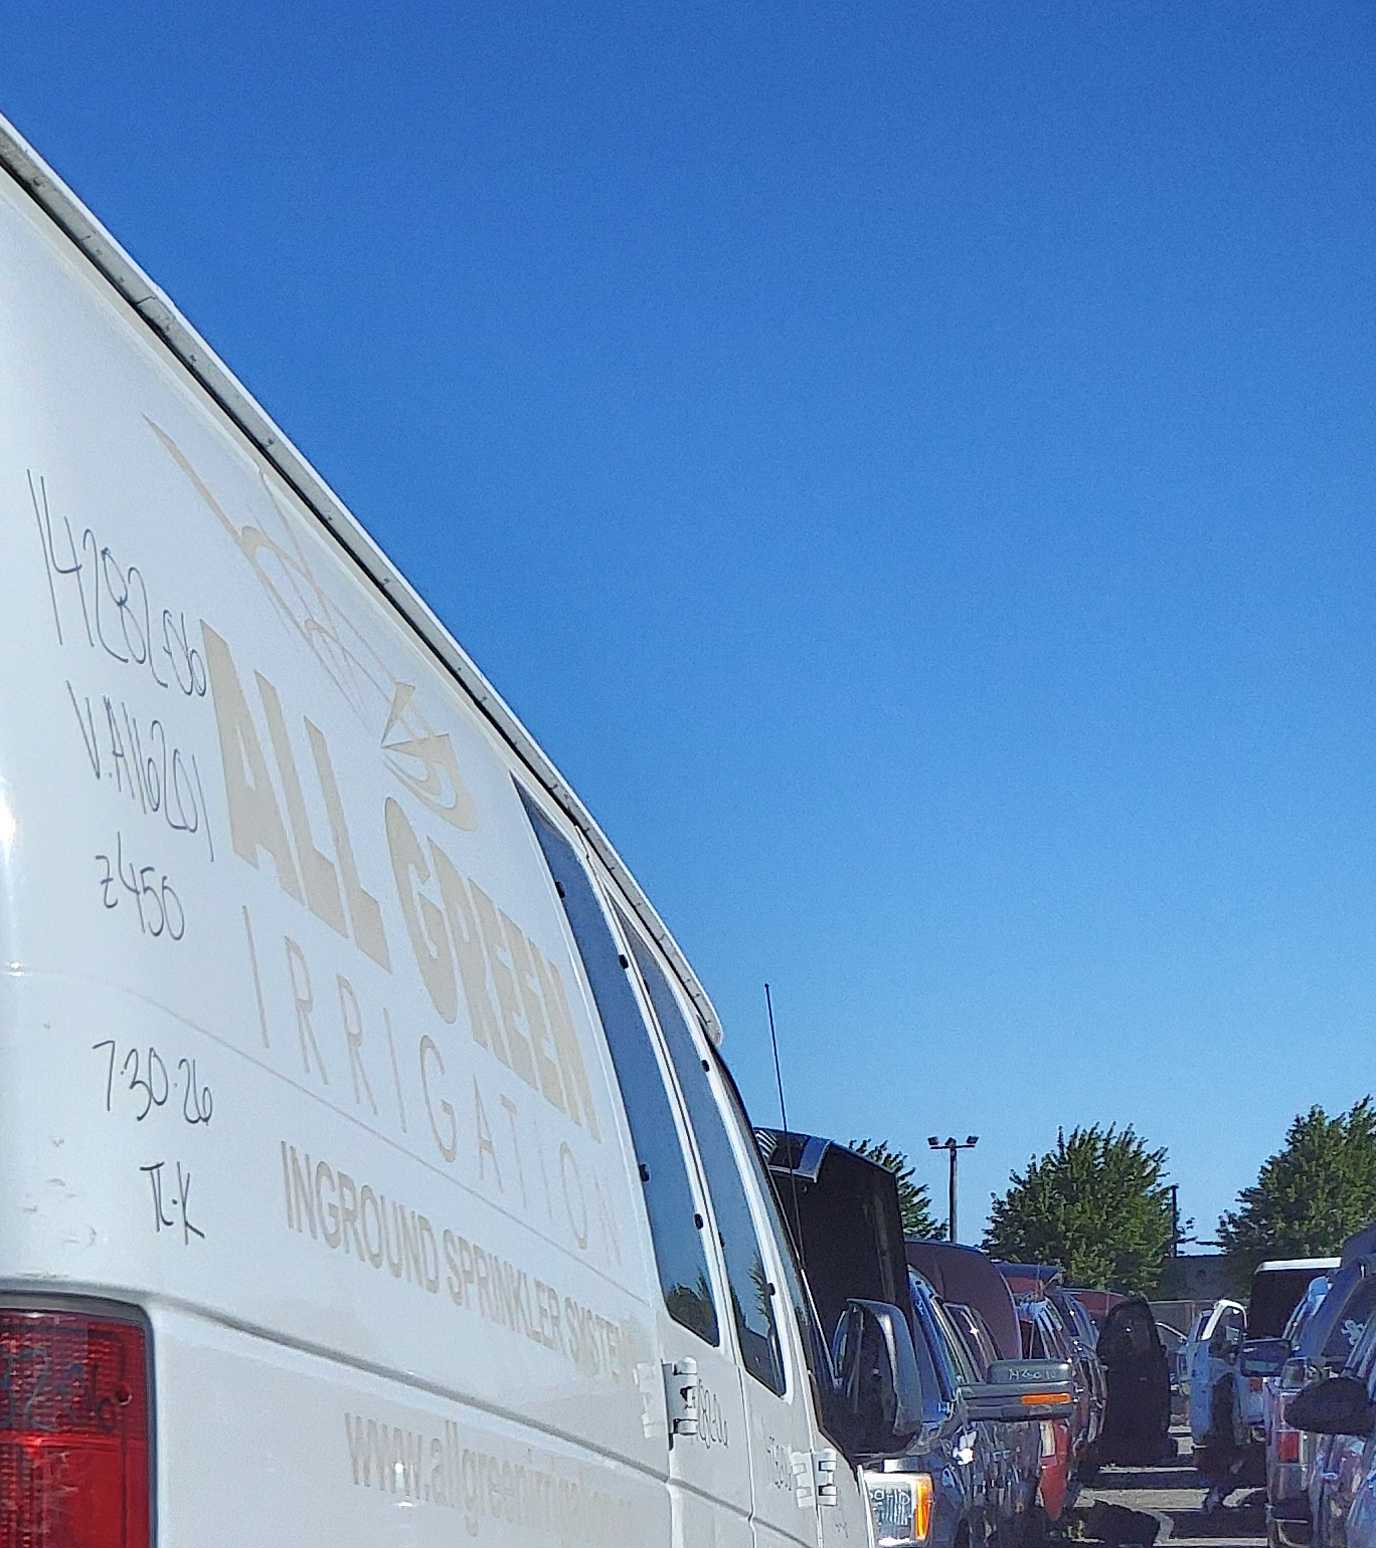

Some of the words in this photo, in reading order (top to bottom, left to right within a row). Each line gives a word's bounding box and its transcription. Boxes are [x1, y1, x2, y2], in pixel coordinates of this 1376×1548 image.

[199, 618, 393, 974] ALL
[384, 796, 604, 1145] GREEN
[241, 904, 623, 1268] IRRIGATION
[280, 1139, 441, 1297] INGROUND
[442, 1227, 564, 1357] SPRINKLER
